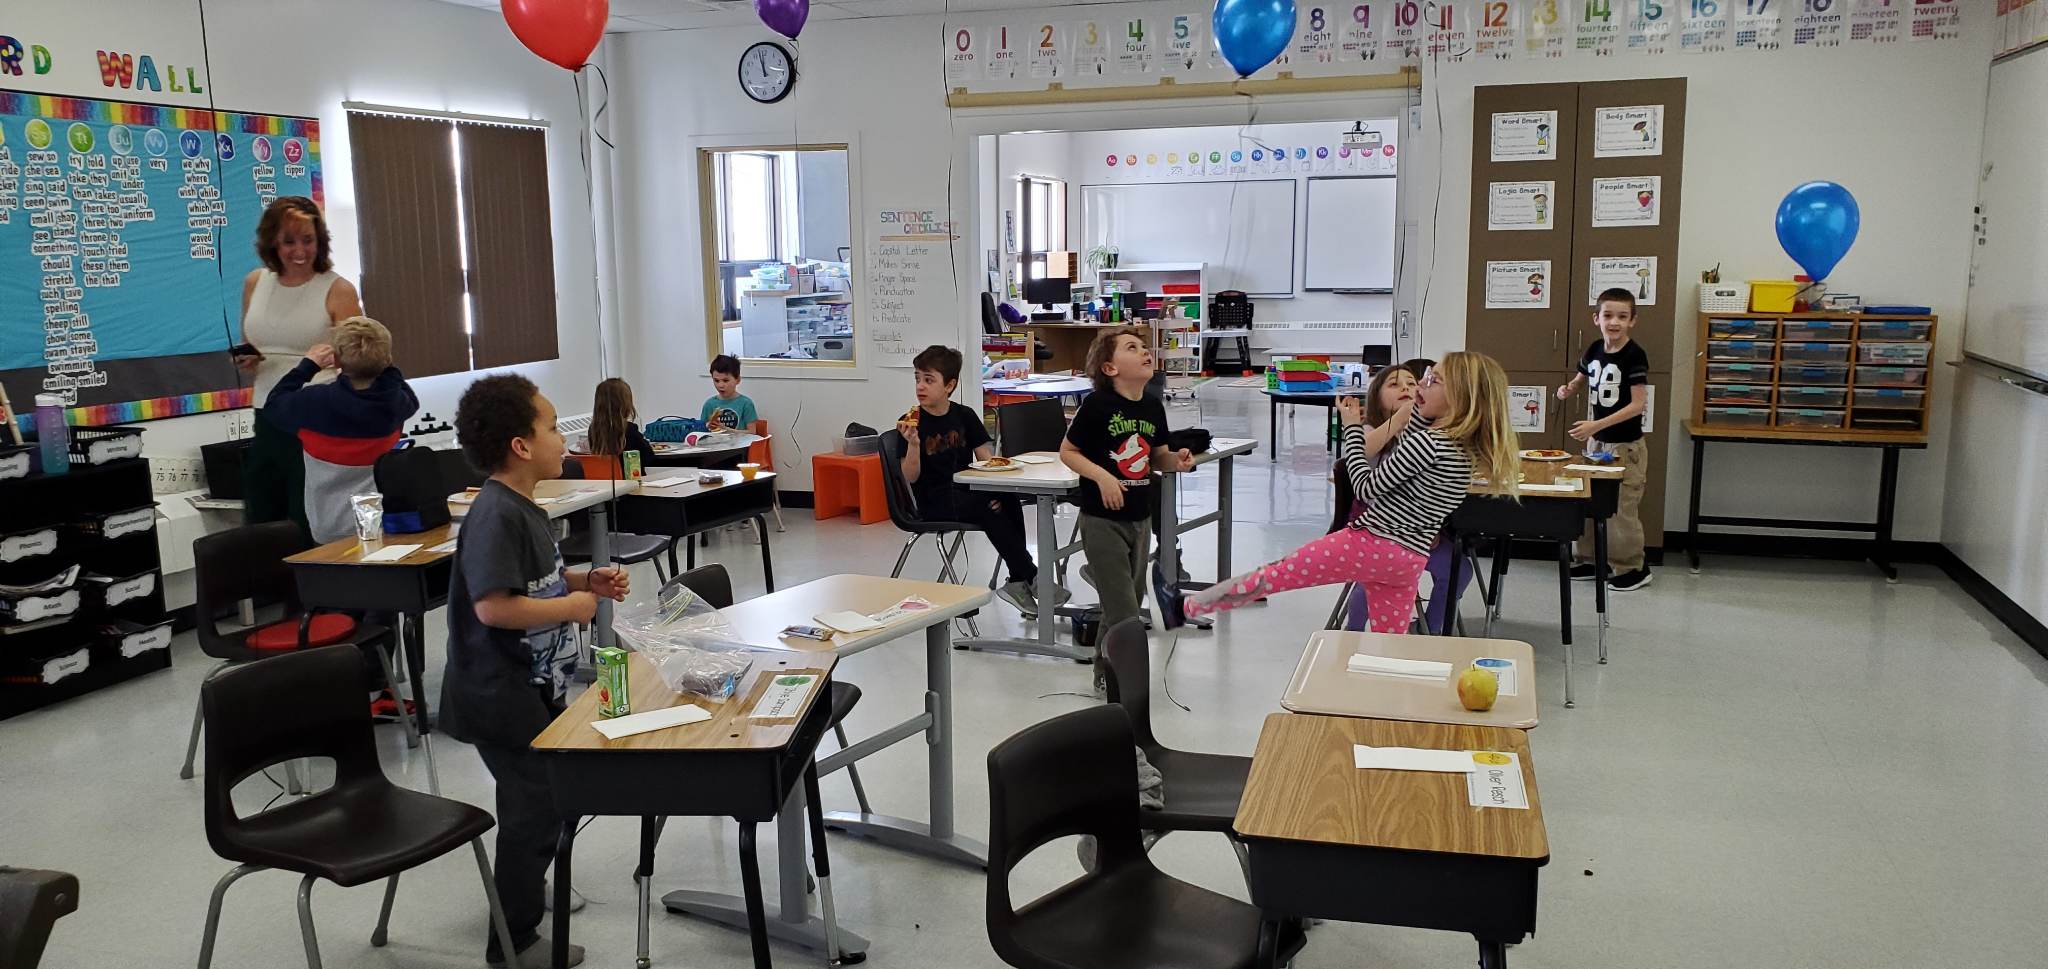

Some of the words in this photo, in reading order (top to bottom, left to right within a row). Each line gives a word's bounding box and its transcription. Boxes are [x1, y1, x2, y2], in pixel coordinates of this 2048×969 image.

[1395, 2, 1418, 27] 10
[1485, 2, 1508, 27] 12
[1914, 5, 1959, 16] twenty
[1311, 8, 1325, 31] 8
[1353, 5, 1370, 28] 9
[1440, 5, 1452, 30] 11
[1795, 15, 1840, 25] eighteen
[1129, 19, 1144, 42] 4
[1174, 16, 1189, 39] 5
[1397, 28, 1412, 36] ten
[1576, 24, 1618, 33] fourteen
[1040, 25, 1054, 47] 2
[1304, 31, 1331, 45] eight
[1349, 29, 1373, 39] nine
[1428, 31, 1465, 41] eleven
[1477, 28, 1514, 38] twelve
[956, 29, 971, 52] 0
[1126, 42, 1146, 51] four
[953, 53, 974, 61] zero
[996, 51, 1014, 59] one
[1038, 49, 1057, 57] two
[96, 50, 203, 93] WALL
[219, 141, 232, 153] Xx
[288, 146, 300, 156] Zz
[69, 156, 81, 167] try
[88, 156, 103, 167] told
[113, 158, 122, 166] up
[150, 161, 165, 170] very
[195, 159, 210, 170] why
[27, 166, 41, 174] she
[131, 168, 139, 176] us
[254, 166, 273, 175] yellow
[286, 167, 304, 176] zipper
[69, 173, 87, 183] take
[91, 174, 108, 186] they
[187, 173, 207, 182] where
[25, 184, 44, 193] sing
[48, 182, 66, 191] said
[122, 180, 144, 188] under
[256, 185, 275, 193] young
[74, 189, 92, 198] than
[95, 189, 115, 199] takes
[180, 187, 197, 196] wish
[200, 186, 218, 197] while
[48, 199, 69, 207] swim
[120, 195, 147, 205] usually
[83, 204, 104, 213] there
[189, 203, 209, 213] which
[32, 213, 53, 223] small
[123, 208, 153, 219] uniform
[880, 211, 934, 222] SENTENCE
[85, 219, 104, 227] three
[110, 218, 123, 227] two
[190, 218, 211, 227] wrong
[903, 221, 959, 234] CHECKLIST
[34, 231, 48, 239] see
[54, 227, 75, 236] stand
[81, 233, 106, 243] throne
[111, 233, 118, 241] to
[191, 232, 211, 242] waved
[33, 242, 77, 253] something
[83, 246, 105, 256] touch
[109, 245, 126, 255] tried
[192, 246, 214, 257] willing
[43, 257, 70, 269] should
[83, 261, 103, 270] these
[109, 260, 128, 269] them
[45, 273, 73, 285] stretch
[86, 275, 98, 284] the
[103, 274, 118, 284] that
[46, 302, 79, 314] spelling
[45, 319, 68, 330] sheep
[72, 318, 87, 327] still
[47, 334, 66, 344] show
[71, 332, 91, 340] some
[70, 341, 96, 354] stayed
[50, 362, 93, 372] swimming
[44, 377, 75, 388] smiling
[79, 373, 105, 384] smiled
[1588, 360, 1622, 408] 28
[1108, 419, 1137, 437] SLIME
[1138, 420, 1156, 437] TIME
[156, 472, 165, 482] 75
[169, 472, 176, 482] 76
